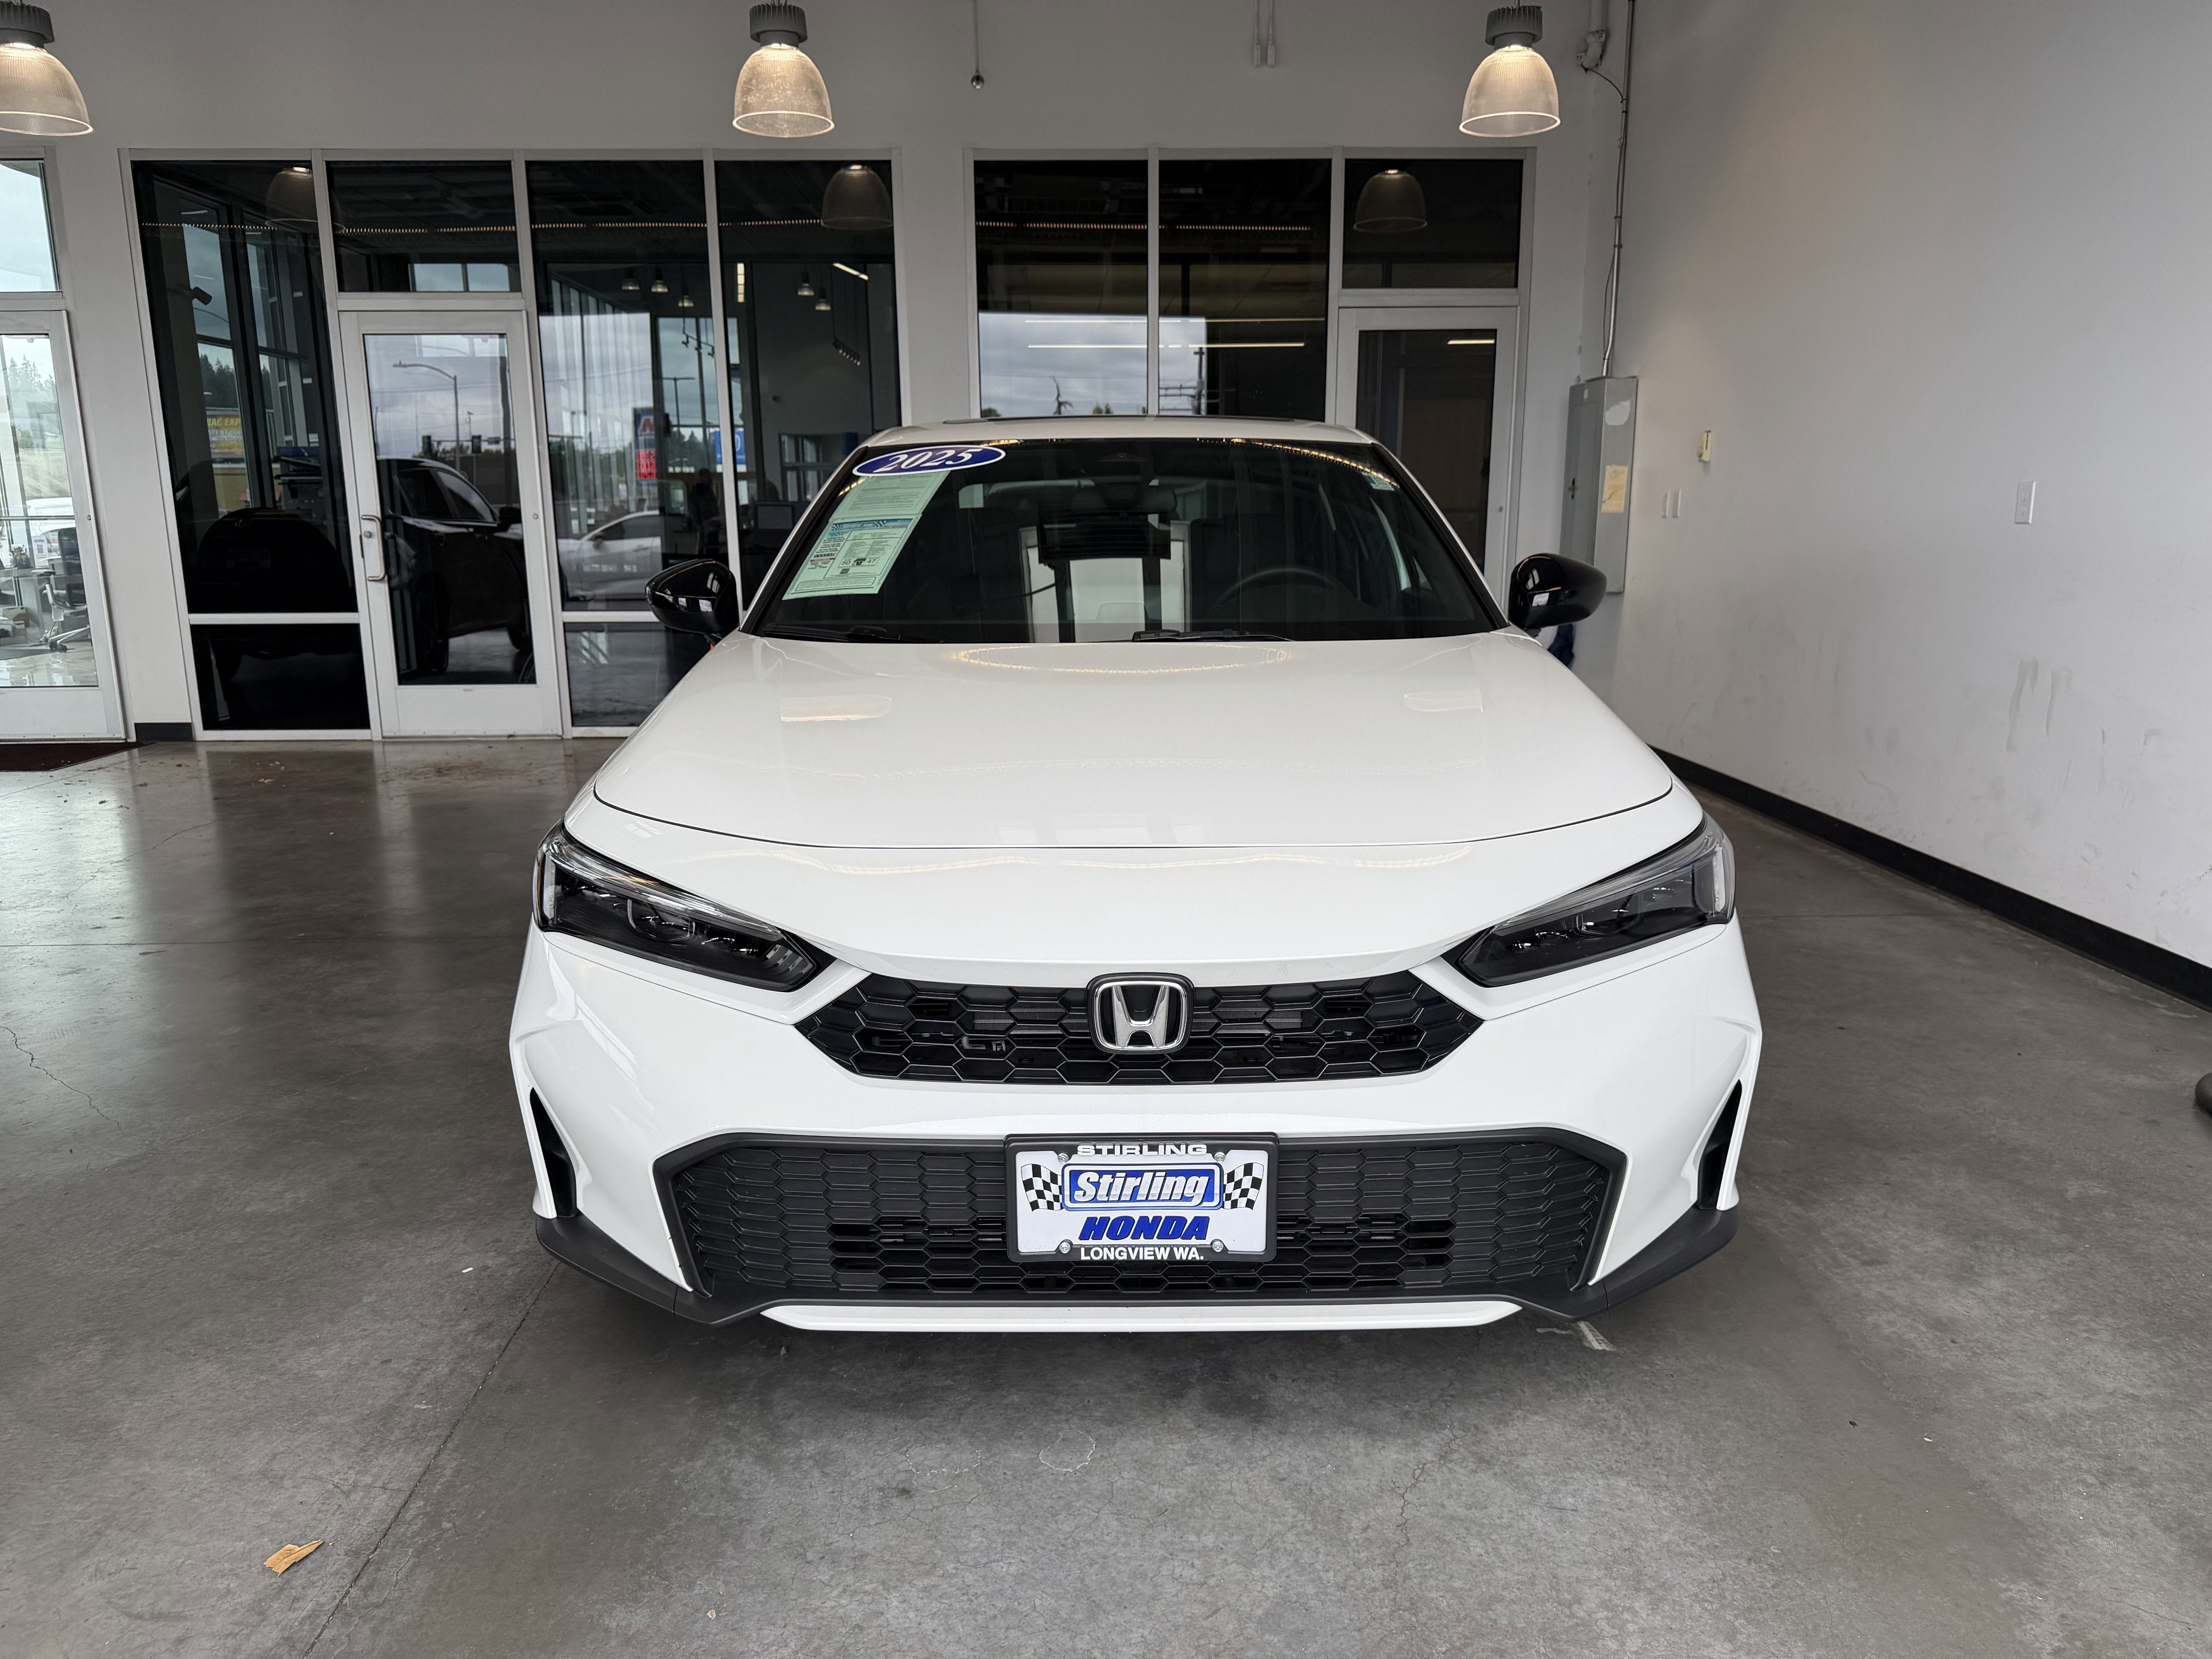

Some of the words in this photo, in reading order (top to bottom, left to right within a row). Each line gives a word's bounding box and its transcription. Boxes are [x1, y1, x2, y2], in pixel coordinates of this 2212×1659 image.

[873, 448, 983, 473] 2025
[1077, 1144, 1207, 1156] STIRLING
[1074, 1171, 1209, 1206] Stirling
[1078, 1216, 1210, 1240] HONDA
[1080, 1247, 1170, 1260] LONGVIEW
[1173, 1247, 1204, 1260] WA.
